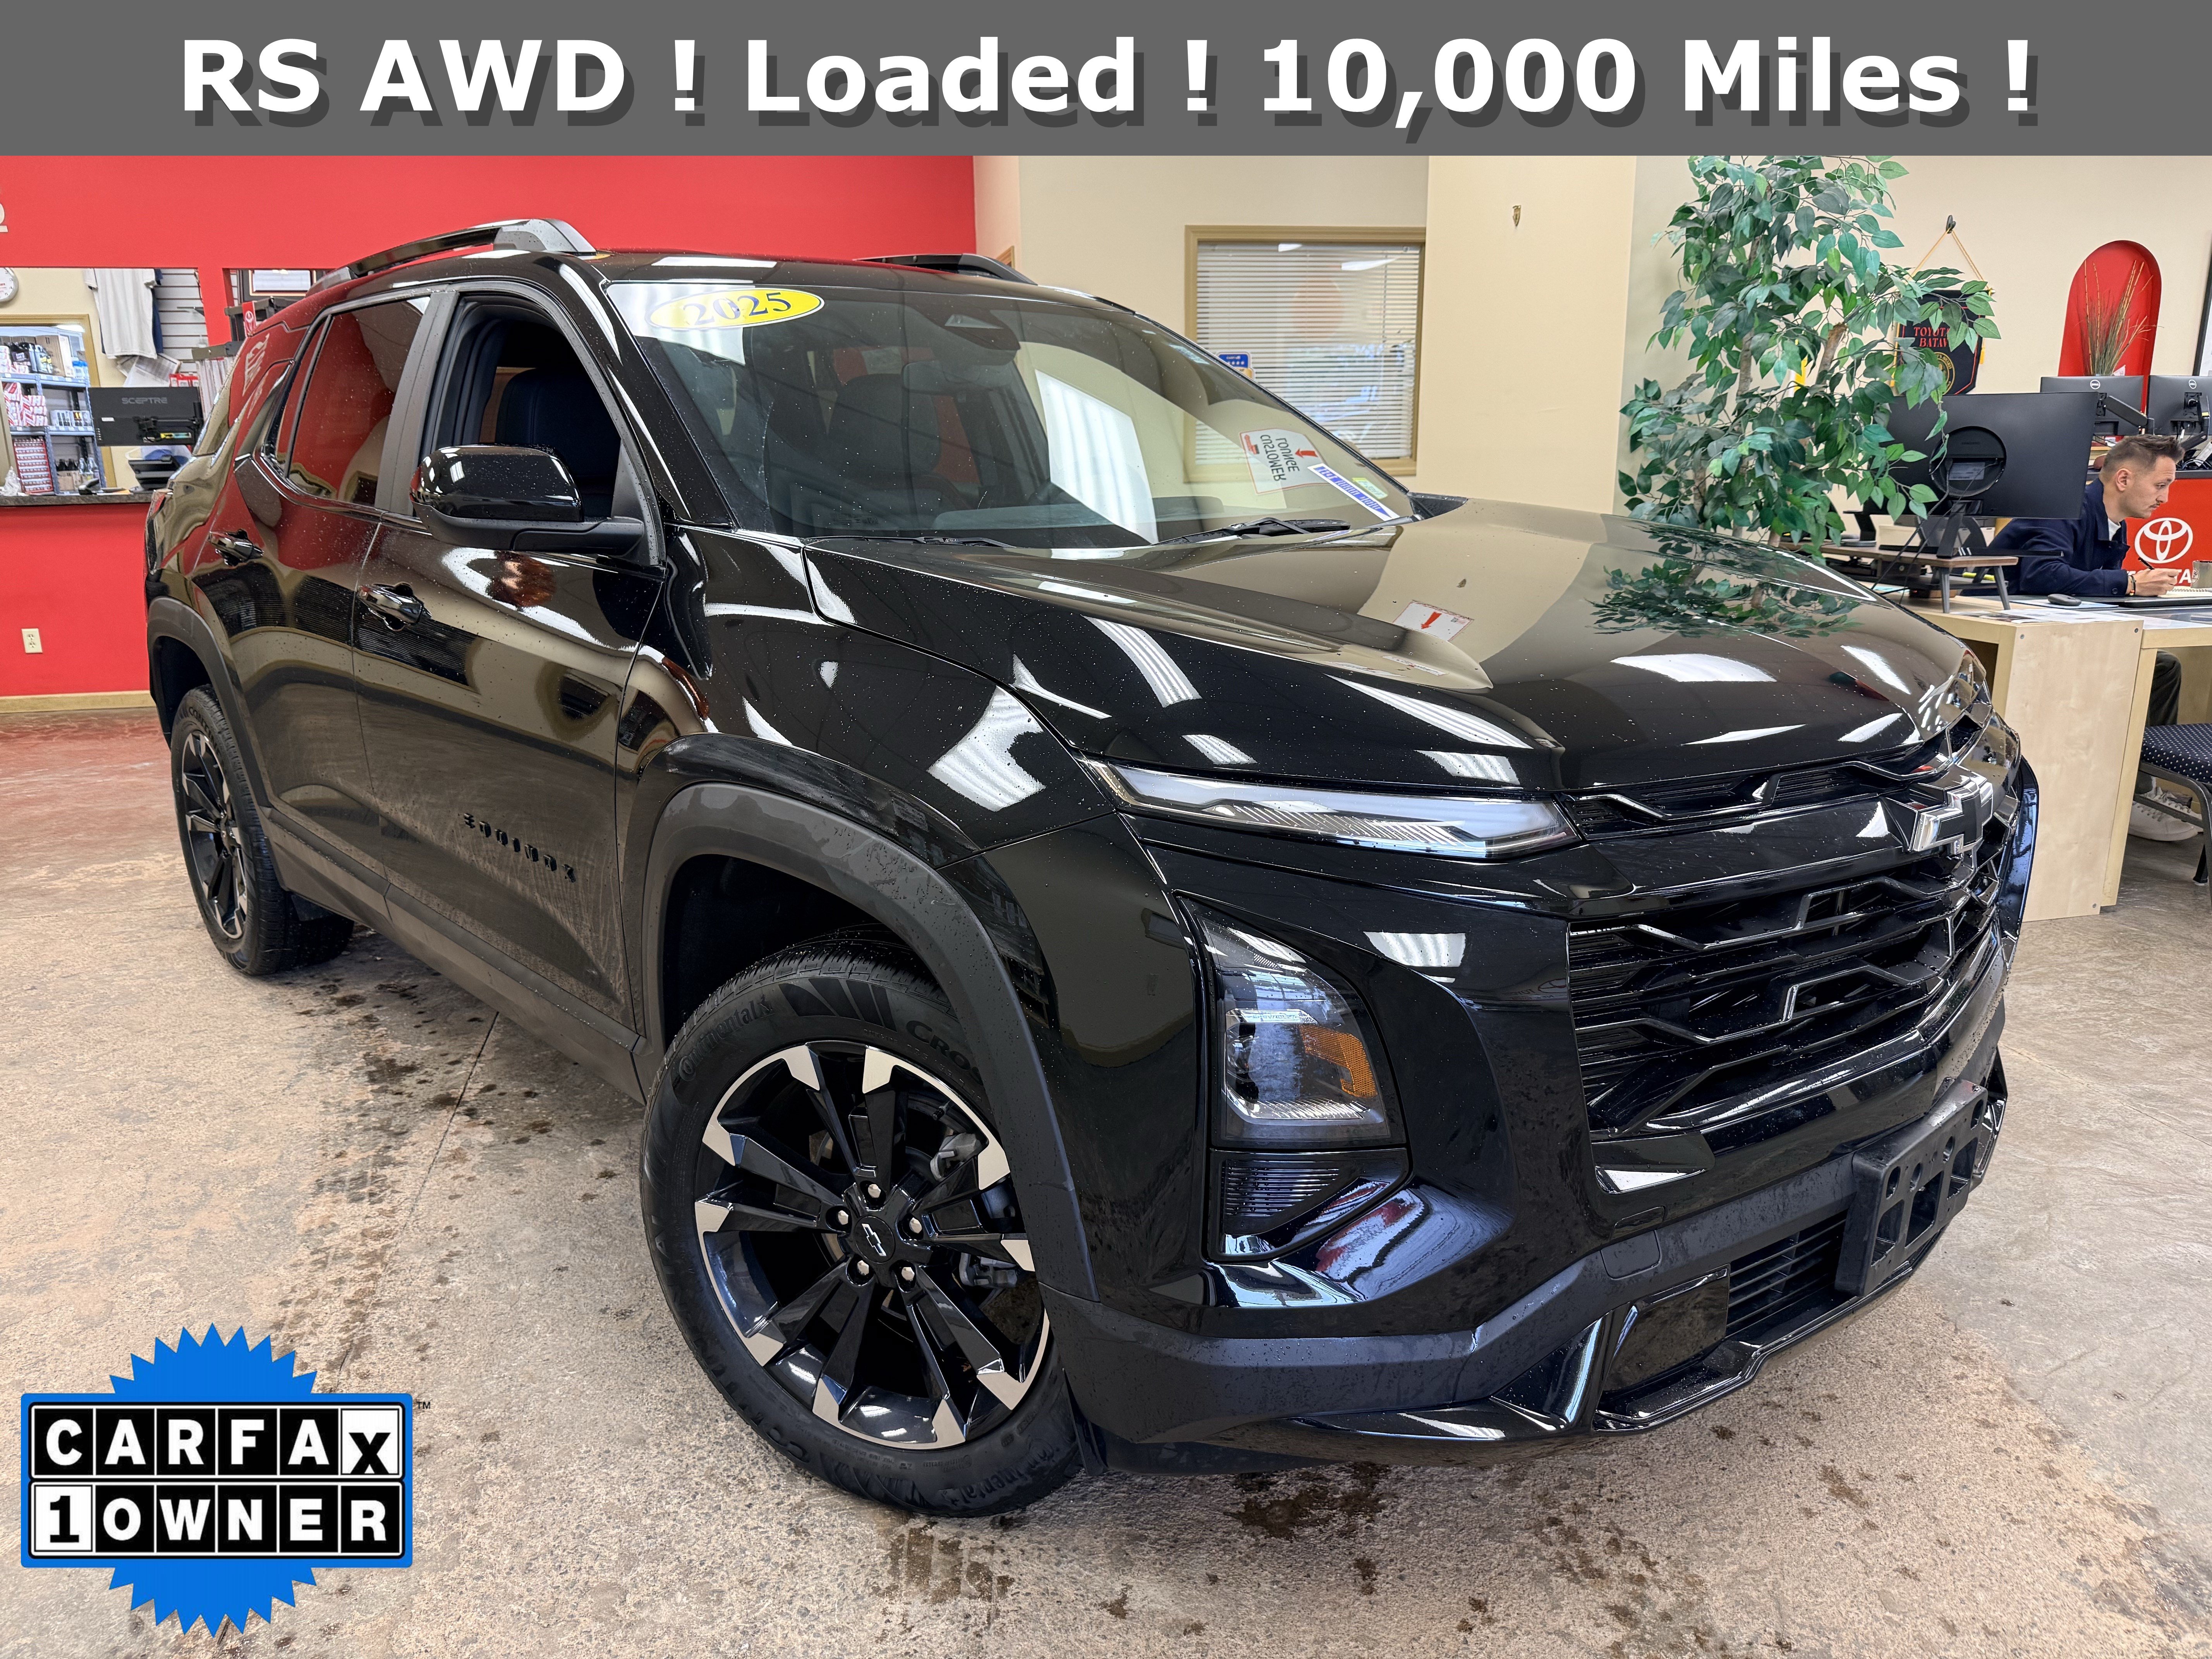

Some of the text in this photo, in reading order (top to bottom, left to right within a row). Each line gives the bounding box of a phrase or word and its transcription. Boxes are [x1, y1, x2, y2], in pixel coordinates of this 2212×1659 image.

[683, 292, 792, 326] 2025
[1919, 338, 1948, 347] BATAV
[122, 397, 168, 405] SCEPTRE
